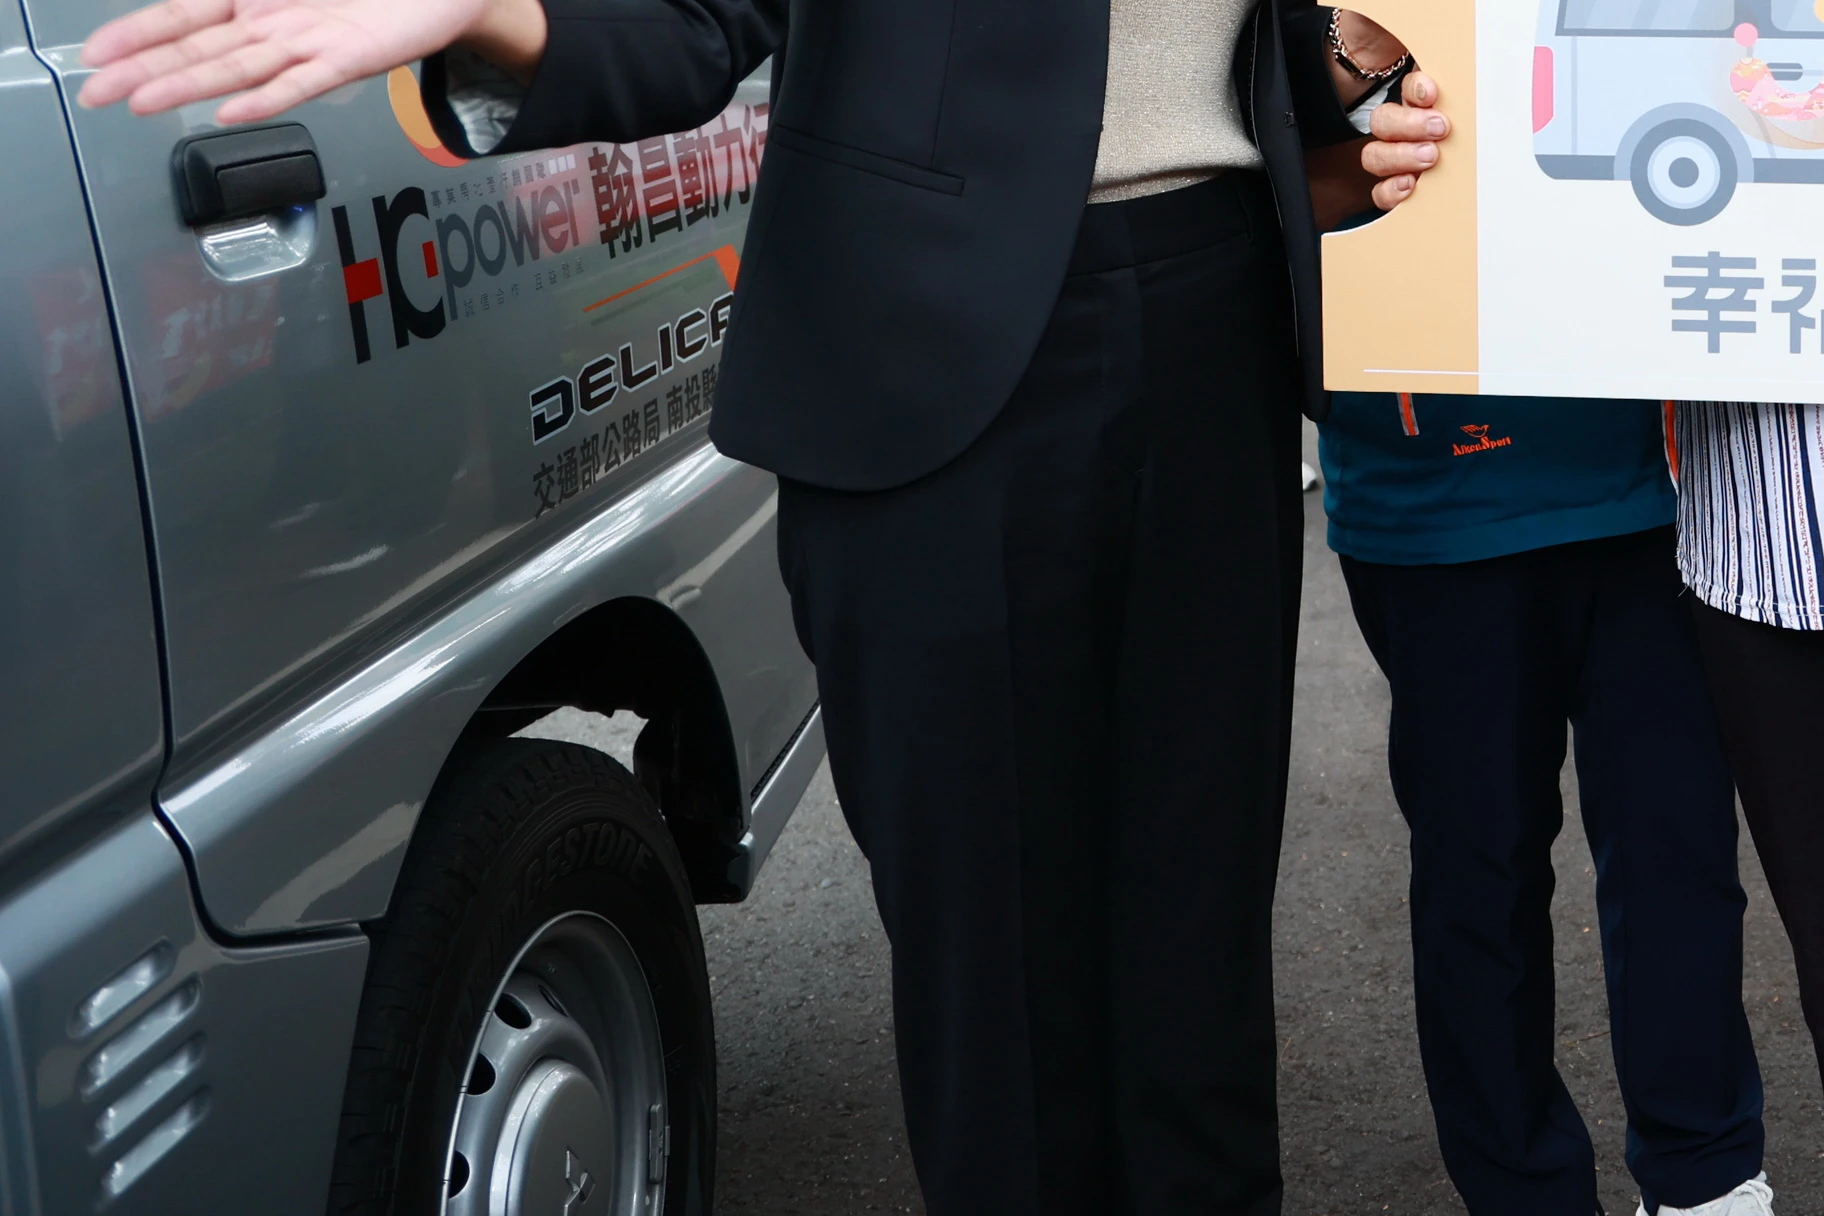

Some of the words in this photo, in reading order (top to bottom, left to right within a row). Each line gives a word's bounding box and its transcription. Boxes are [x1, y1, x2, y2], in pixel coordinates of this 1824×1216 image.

[532, 397, 662, 519] 交通部公路局
